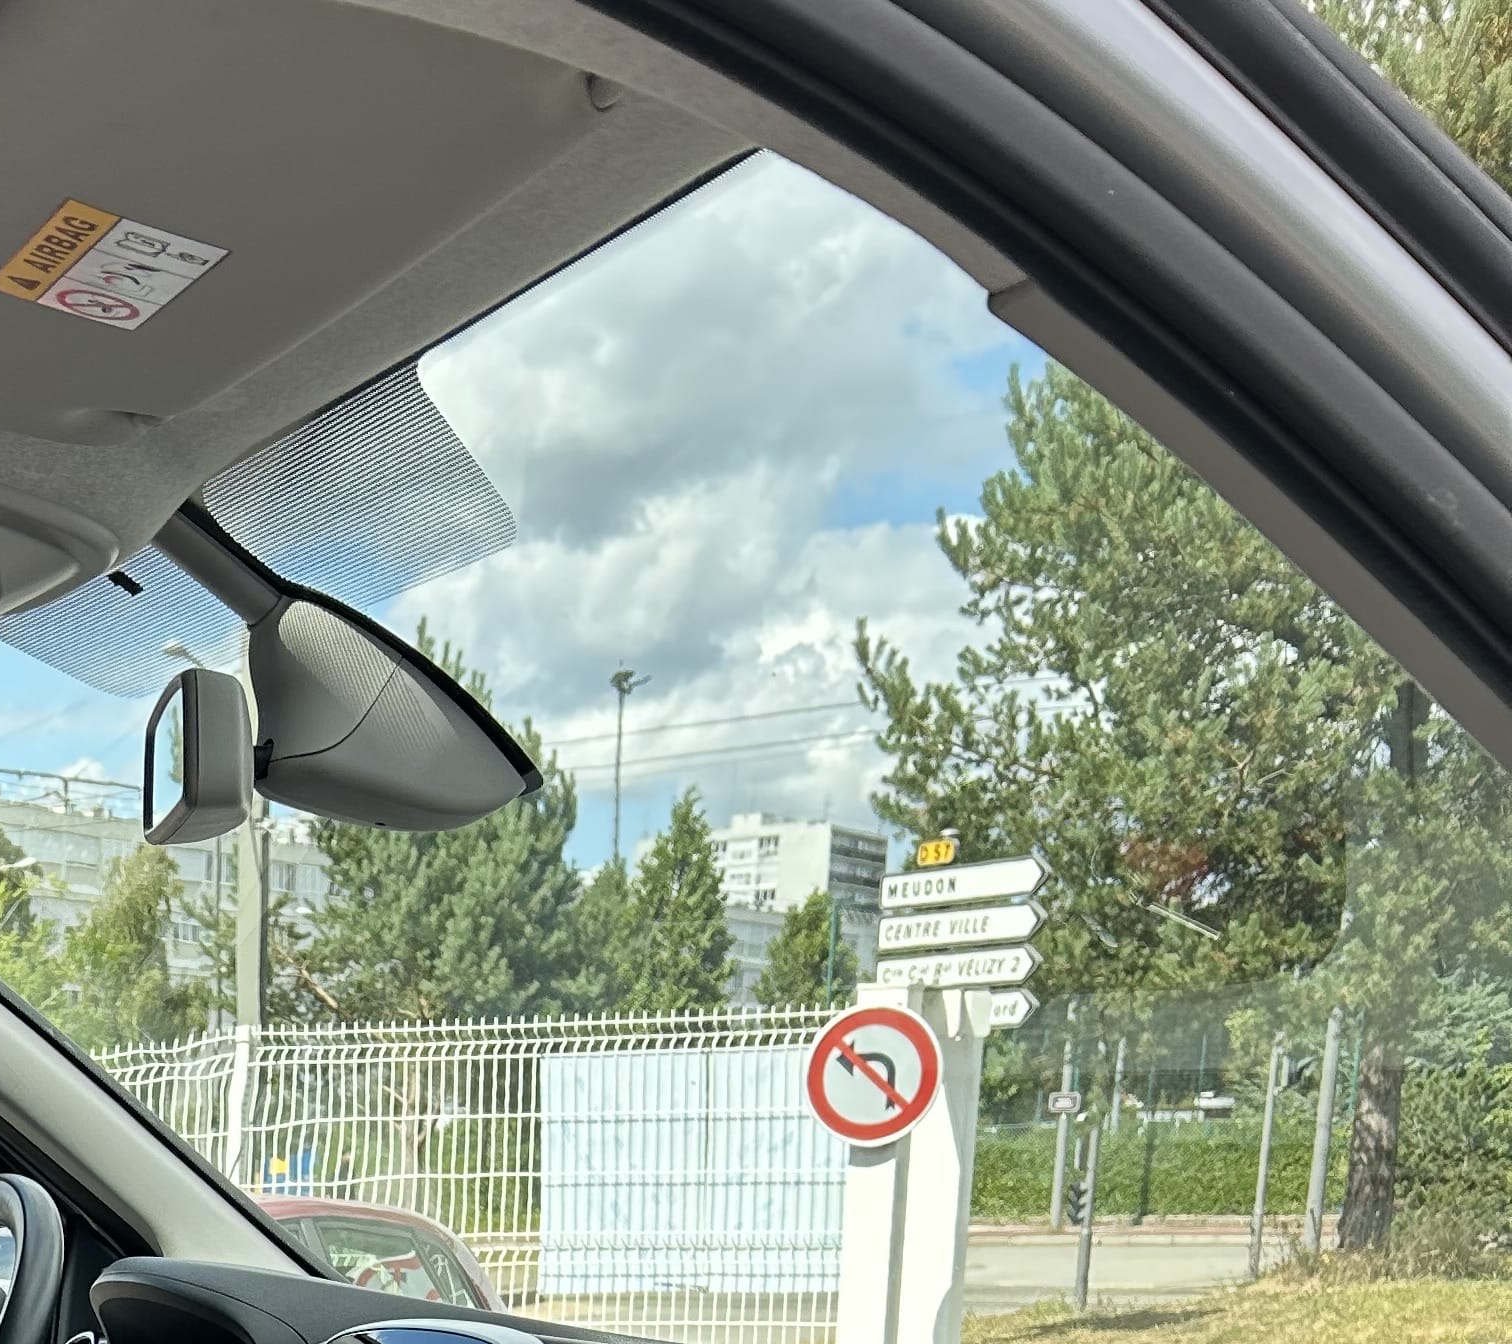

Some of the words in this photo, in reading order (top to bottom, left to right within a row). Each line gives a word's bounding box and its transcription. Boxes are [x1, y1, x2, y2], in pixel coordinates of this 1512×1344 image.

[24, 215, 99, 274] AIRBAG
[919, 845, 929, 862] D
[888, 877, 957, 898] MEUDON
[885, 920, 942, 942] CENTRE
[950, 915, 989, 935] VILLE
[1010, 955, 1021, 973] 2
[993, 1000, 1019, 1017] ord
